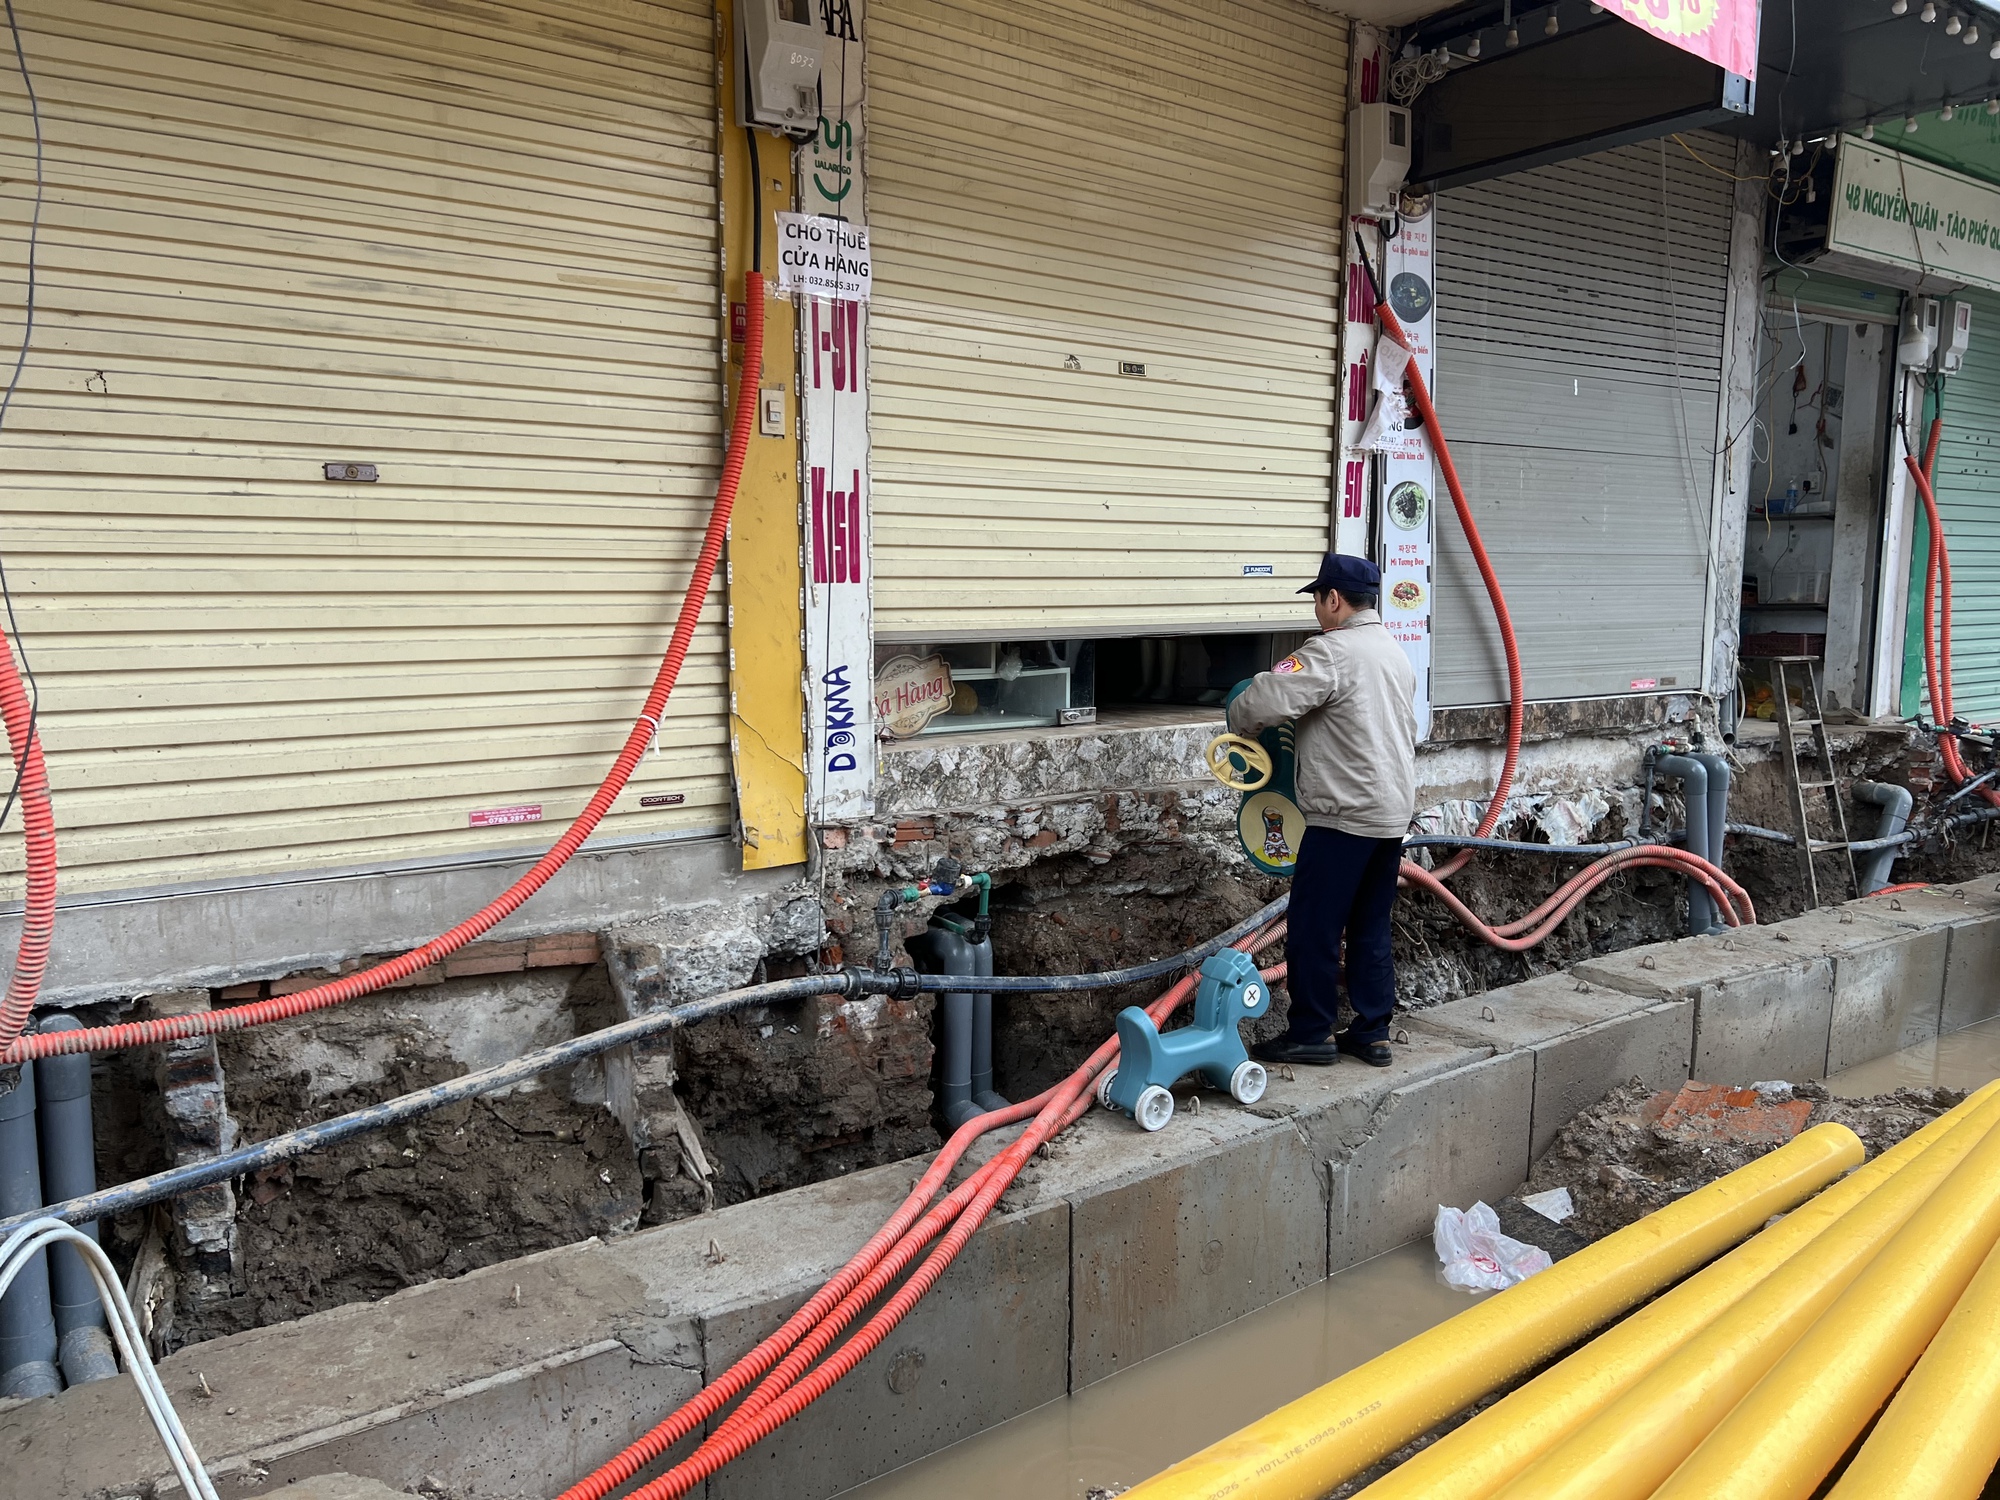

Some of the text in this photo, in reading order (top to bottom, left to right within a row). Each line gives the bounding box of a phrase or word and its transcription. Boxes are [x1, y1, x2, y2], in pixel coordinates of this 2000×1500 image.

[790, 51, 815, 68] 8032
[1846, 183, 1861, 211] 48
[1862, 187, 1907, 223] NGUYỄN
[1909, 201, 1939, 232] TUÂN
[1946, 211, 1967, 240] TÀO
[1967, 219, 1990, 246] PHỚ
[785, 223, 867, 250] CHO THUÊ
[782, 246, 869, 277] CỬA HÀNG
[793, 274, 808, 285] LH:
[893, 675, 933, 706] Hàng
